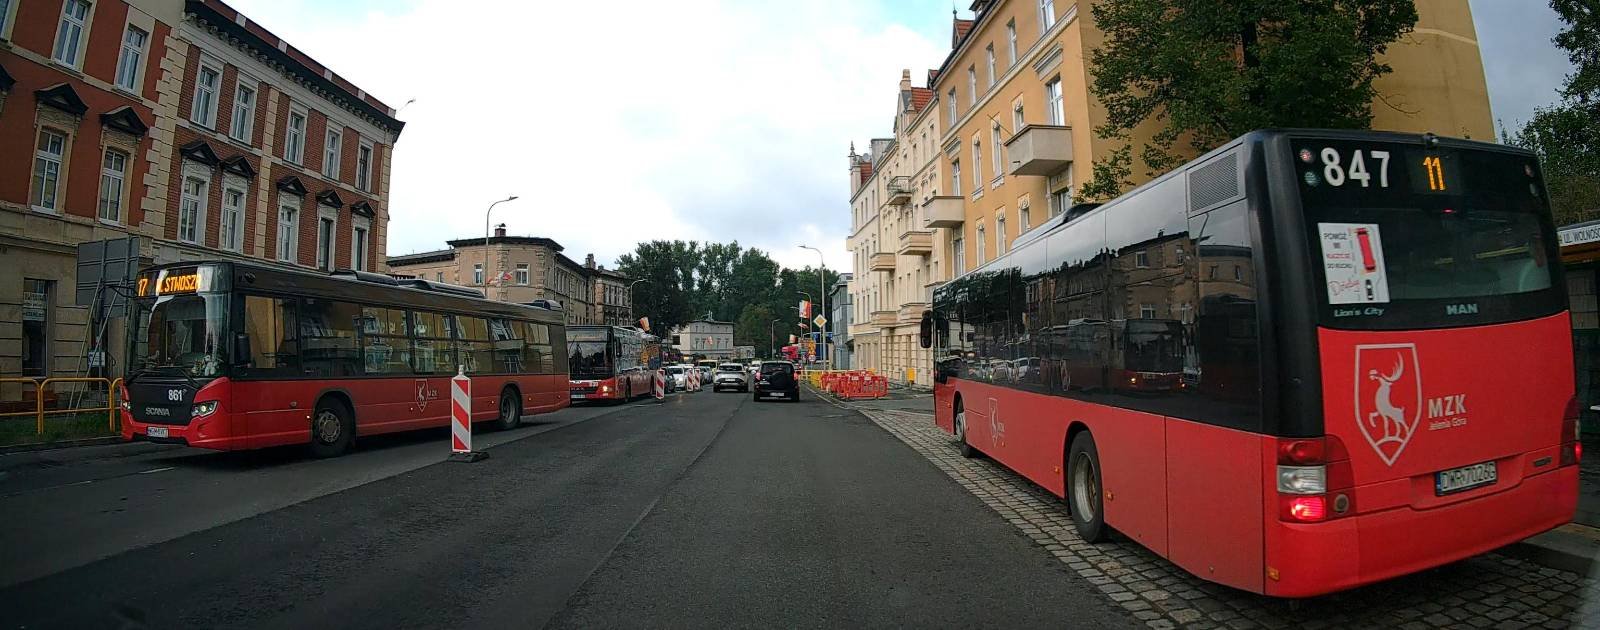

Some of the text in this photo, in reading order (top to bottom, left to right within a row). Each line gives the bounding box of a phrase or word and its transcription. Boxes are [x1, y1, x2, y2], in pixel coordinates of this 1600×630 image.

[1321, 148, 1390, 188] 847
[1423, 156, 1446, 191] 11
[138, 279, 148, 296] 17
[1446, 303, 1478, 315] MAN
[168, 389, 183, 402] 861
[145, 407, 170, 417] SCANIA
[1428, 394, 1466, 418] MZK
